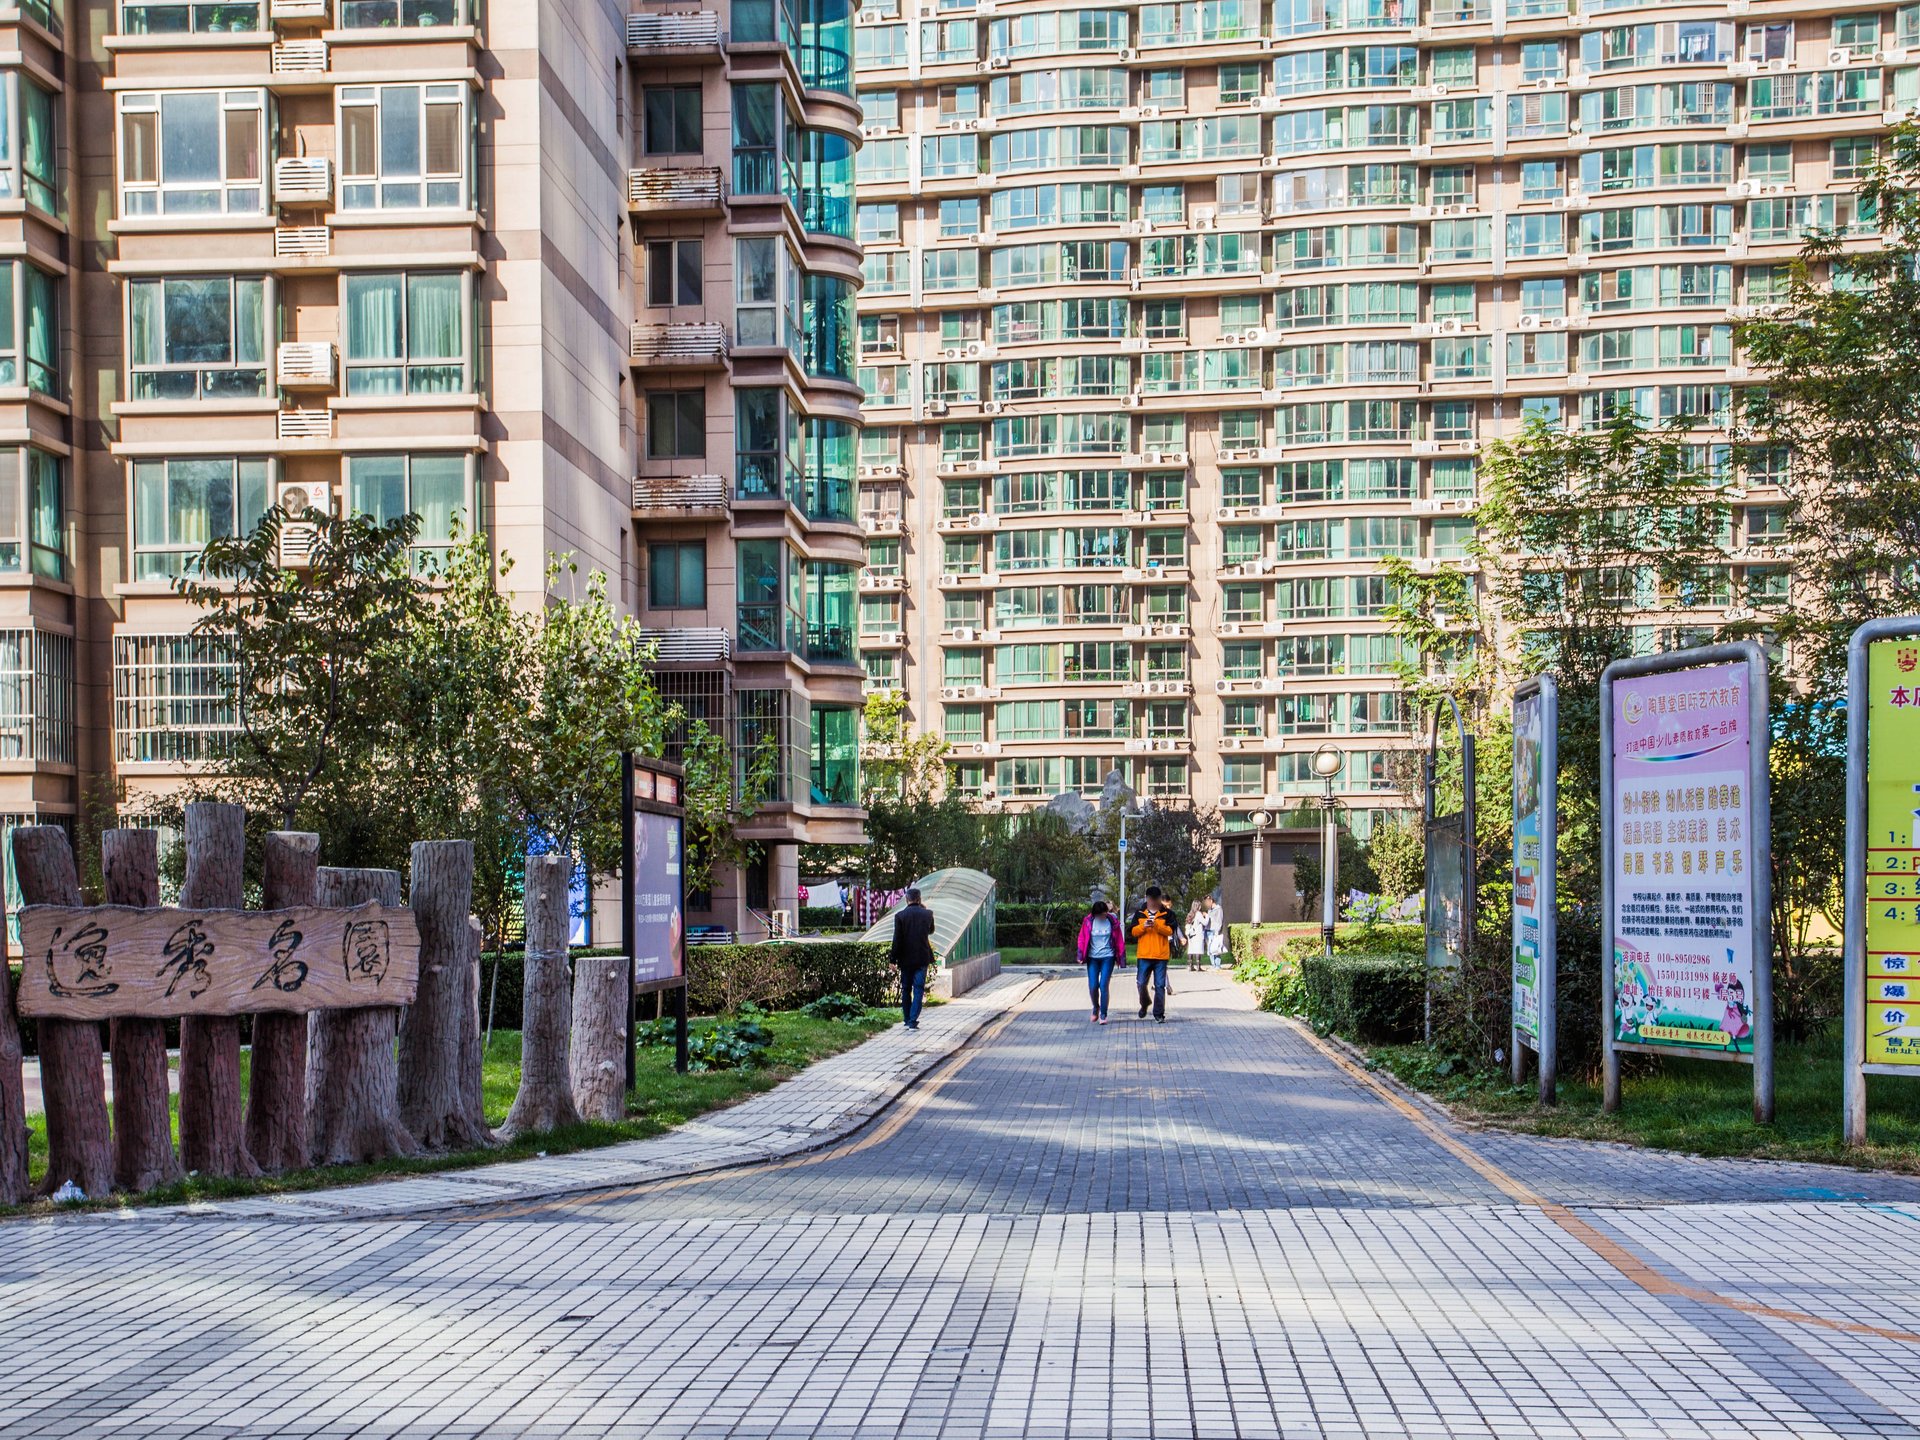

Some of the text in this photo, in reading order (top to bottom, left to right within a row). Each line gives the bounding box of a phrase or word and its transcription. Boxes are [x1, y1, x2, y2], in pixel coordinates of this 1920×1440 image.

[1626, 719, 1737, 753] 打造中国少儿素质教育第一品牌
[1623, 784, 1741, 814] 幼小衔接 幼儿托管 跆拳道
[1623, 816, 1741, 845] 精品英语 主持表演 美术
[1623, 851, 1644, 875] 舞蹈
[1652, 850, 1674, 875] 书法
[1622, 951, 1710, 965] 咨询电话 010-89502986
[1656, 969, 1738, 985] 15501131998 杨老师
